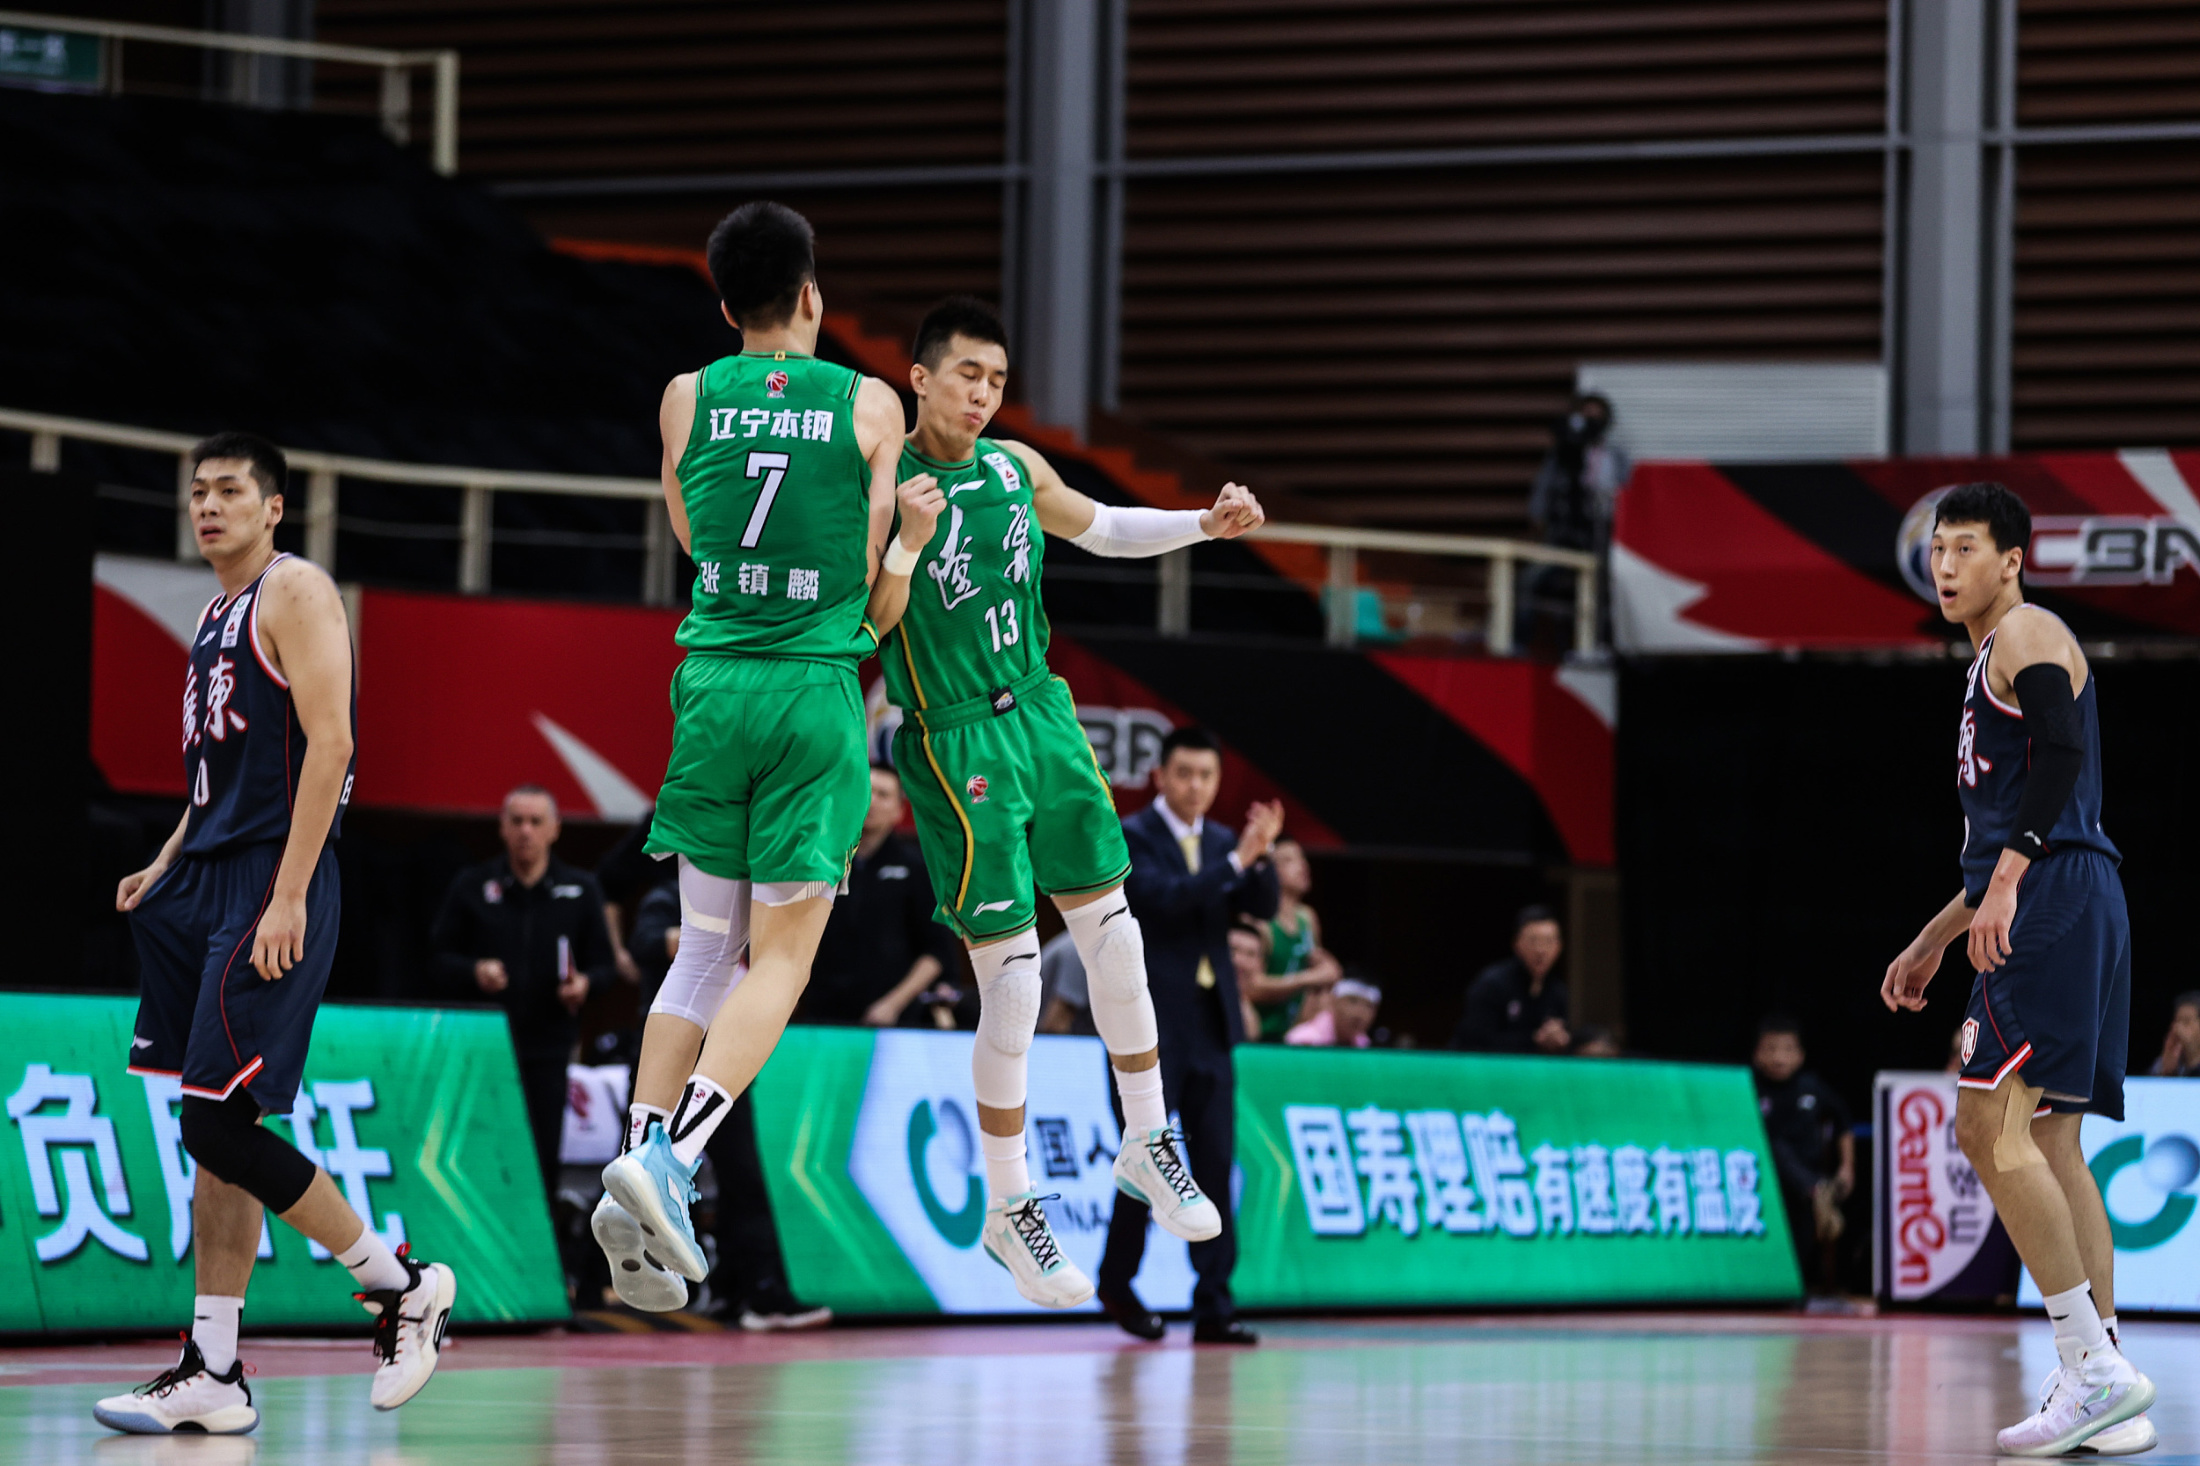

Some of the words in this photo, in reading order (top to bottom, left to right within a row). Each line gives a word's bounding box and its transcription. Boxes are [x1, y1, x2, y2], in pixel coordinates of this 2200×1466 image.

[709, 407, 834, 443] 辽宁本钢
[738, 451, 791, 550] 7
[701, 561, 820, 602] 张镇麟
[2024, 516, 2200, 587] CBA
[984, 598, 1020, 653] 13
[1076, 706, 1173, 788] BA
[1034, 1115, 1118, 1180] 国人
[1898, 1089, 1946, 1286] Ganten
